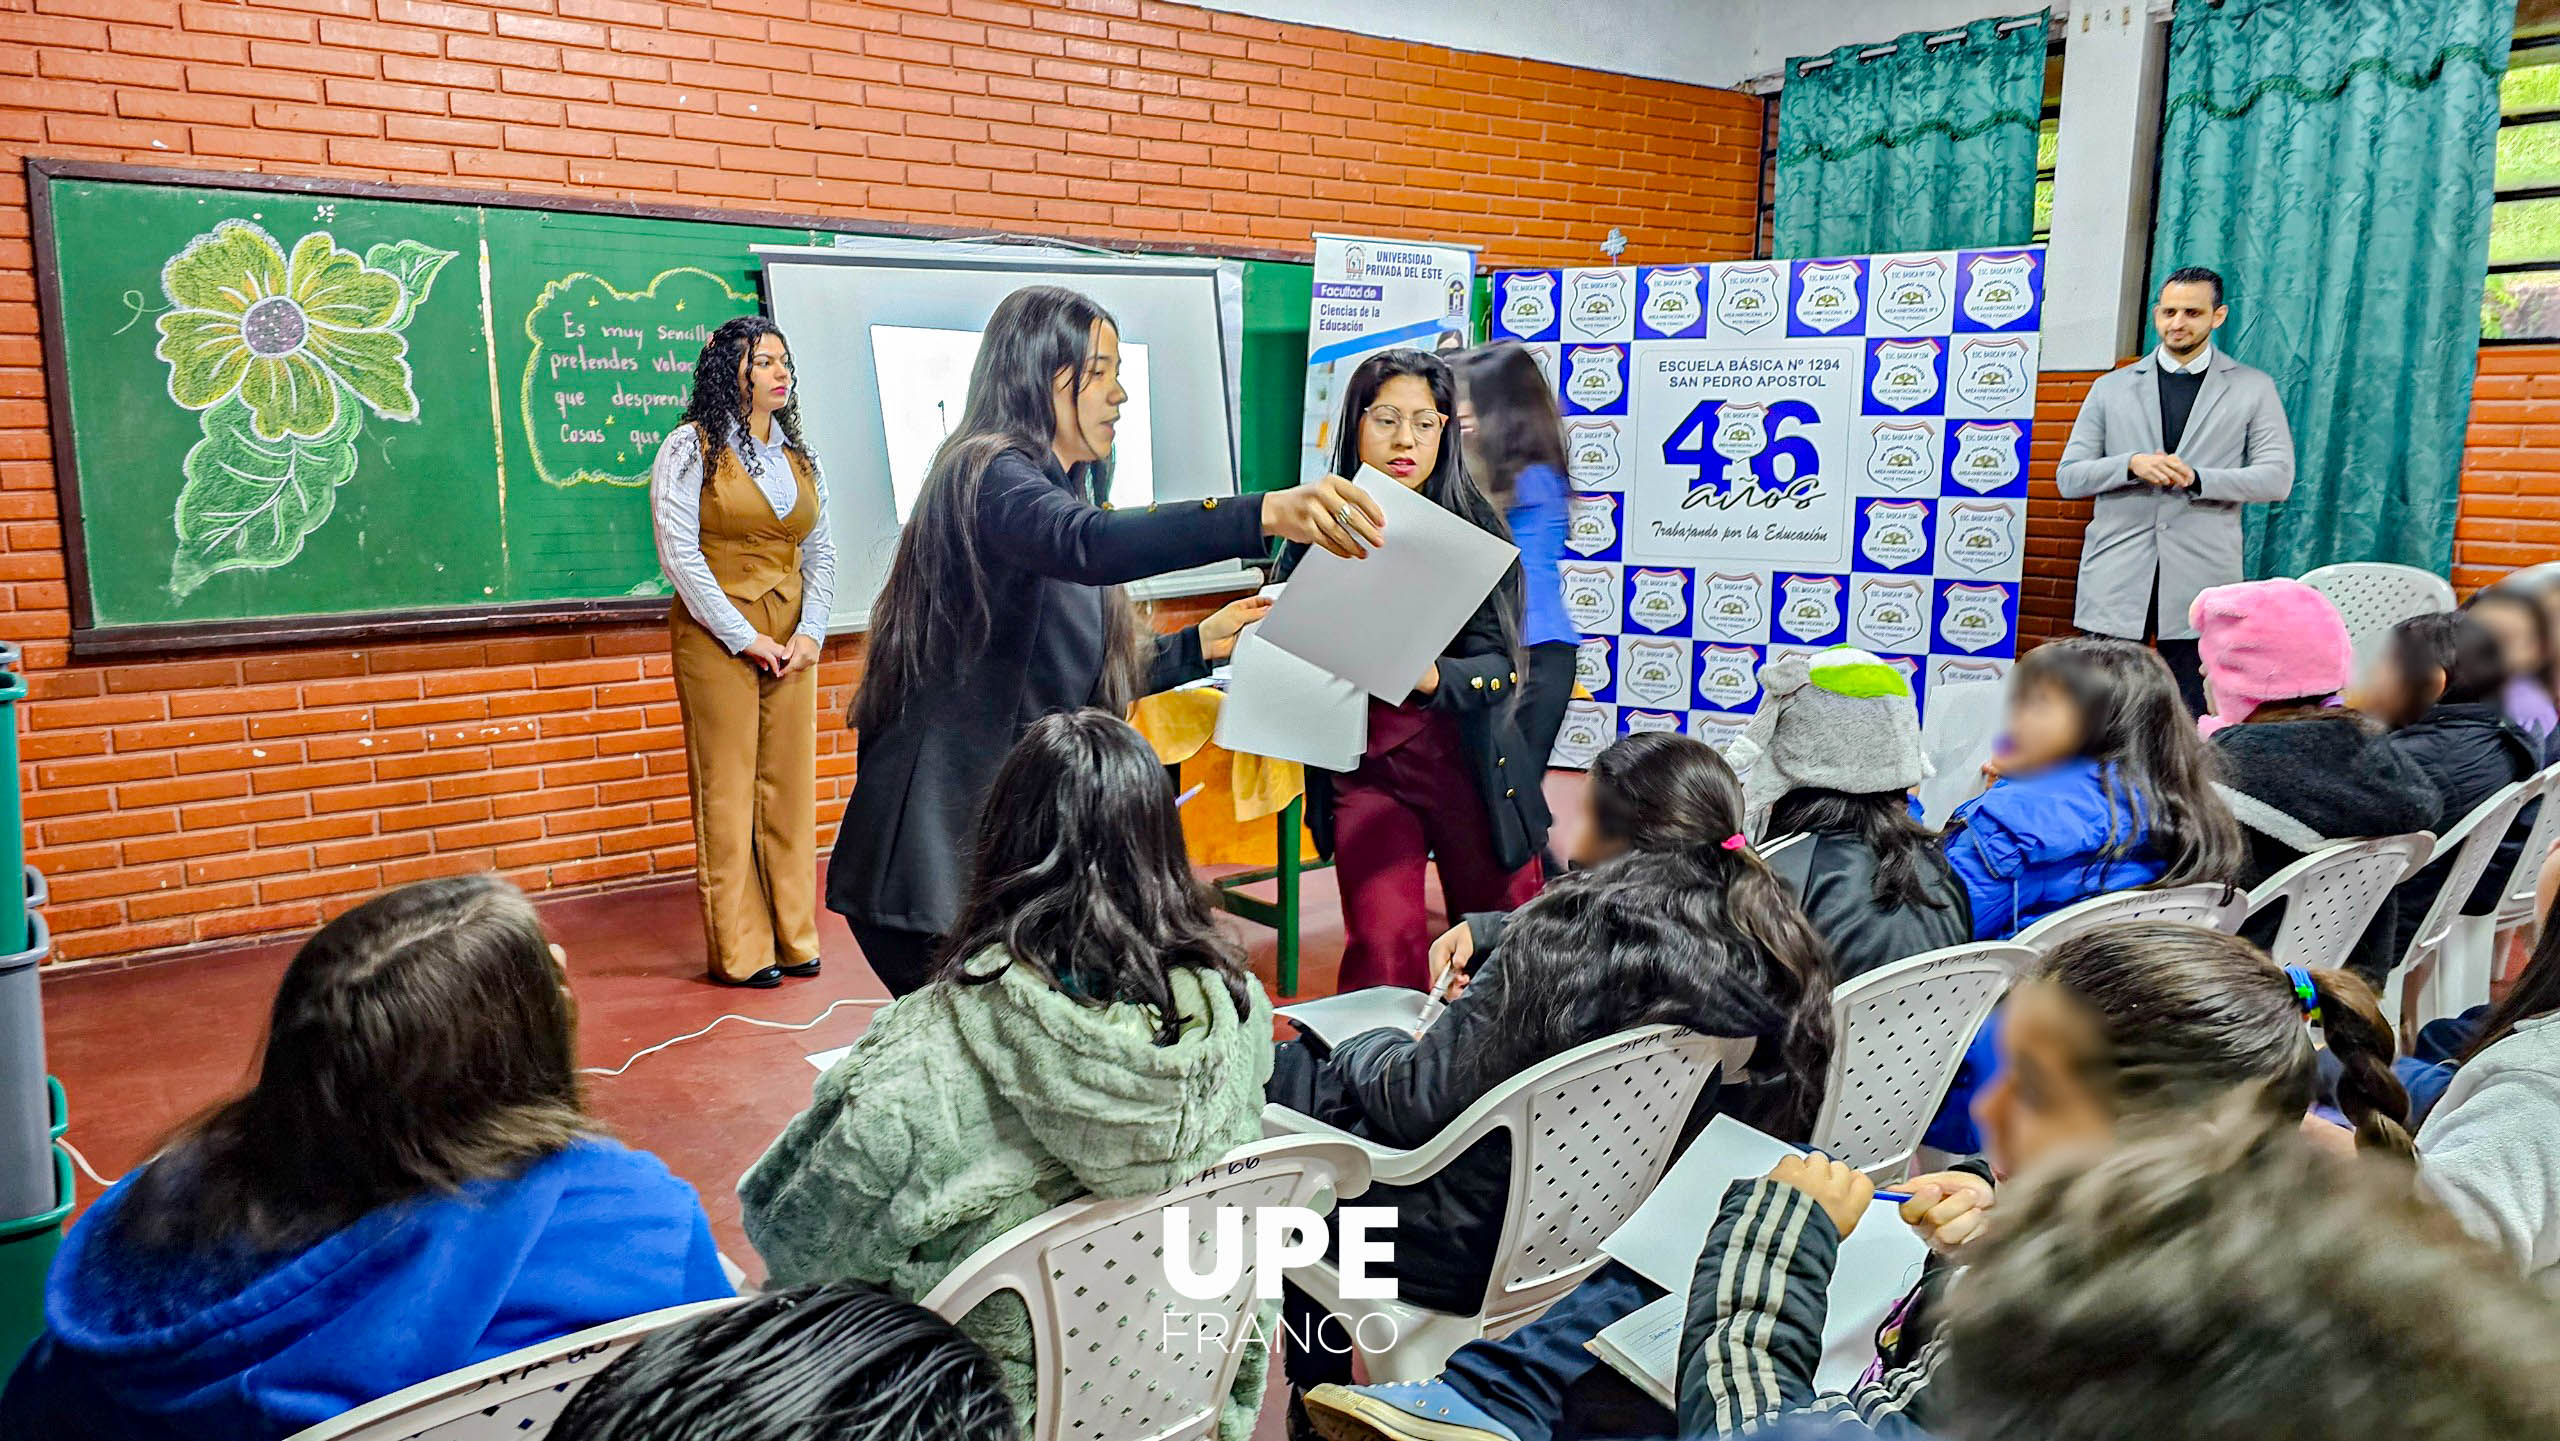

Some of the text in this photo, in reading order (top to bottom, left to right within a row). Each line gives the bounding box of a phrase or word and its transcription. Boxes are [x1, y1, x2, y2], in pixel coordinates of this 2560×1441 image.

[1376, 250, 1432, 265] UNIVERSIDAD
[1365, 264, 1402, 277] PRIVADA
[1404, 266, 1418, 279] DEL
[1421, 268, 1443, 280] ESTE
[1320, 284, 1377, 299] Facultad de
[1320, 304, 1380, 318] Ciencias de la
[564, 312, 585, 338] Es
[601, 327, 643, 349] muy
[1319, 319, 1363, 332] Educación
[551, 344, 637, 379] pretendes
[1658, 356, 1840, 373] ESCUELA BÁSICA Nº 1294
[1669, 375, 1827, 388] SAN PEDRO APOSTOL
[555, 381, 688, 419] que desprend
[560, 424, 660, 454] Cosas que
[1661, 399, 1822, 498] 46
[1680, 474, 1827, 511] años
[1651, 520, 1828, 542] Trabajando por la Educación
